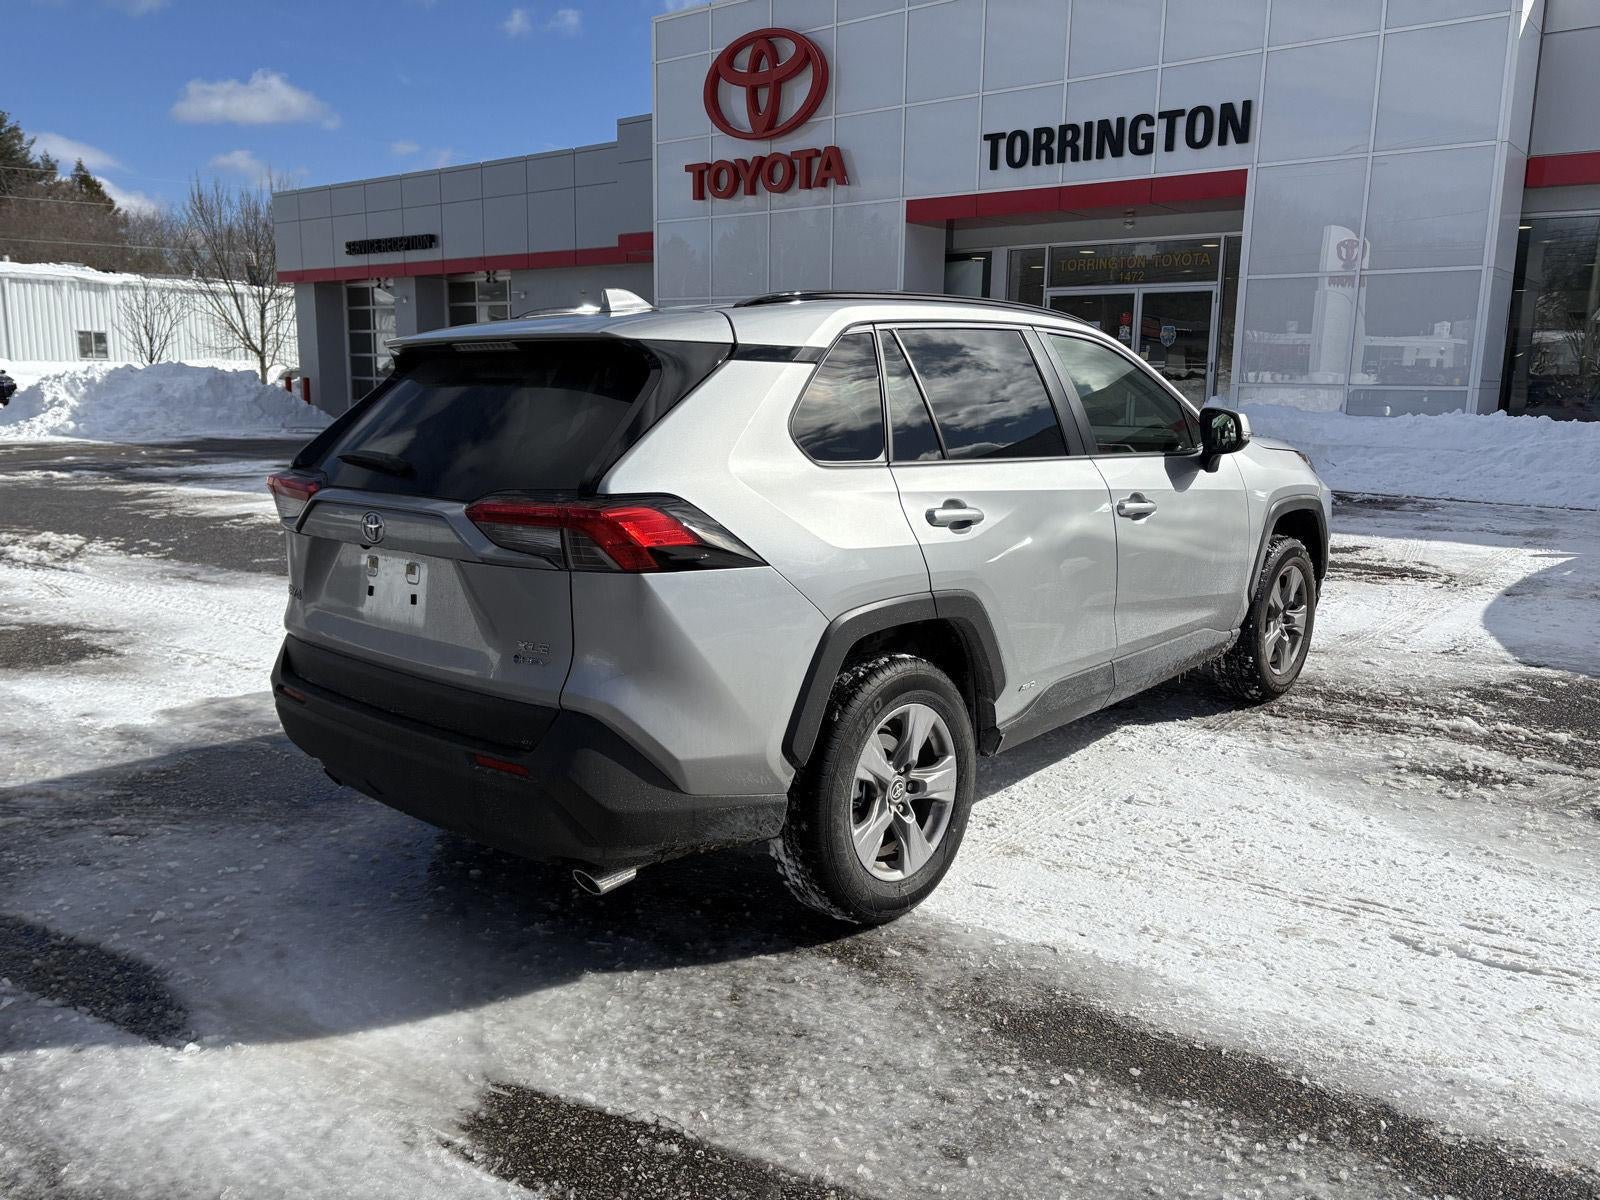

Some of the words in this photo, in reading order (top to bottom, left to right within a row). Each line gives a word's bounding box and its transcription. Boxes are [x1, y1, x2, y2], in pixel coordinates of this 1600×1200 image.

[983, 99, 1252, 171] TORRINGTON
[685, 145, 849, 201] TOYOTA
[380, 234, 437, 252] RECEPTION
[1060, 255, 1147, 272] TORRINGTON
[1152, 252, 1211, 268] TOYOTA
[1119, 271, 1145, 283] 1472
